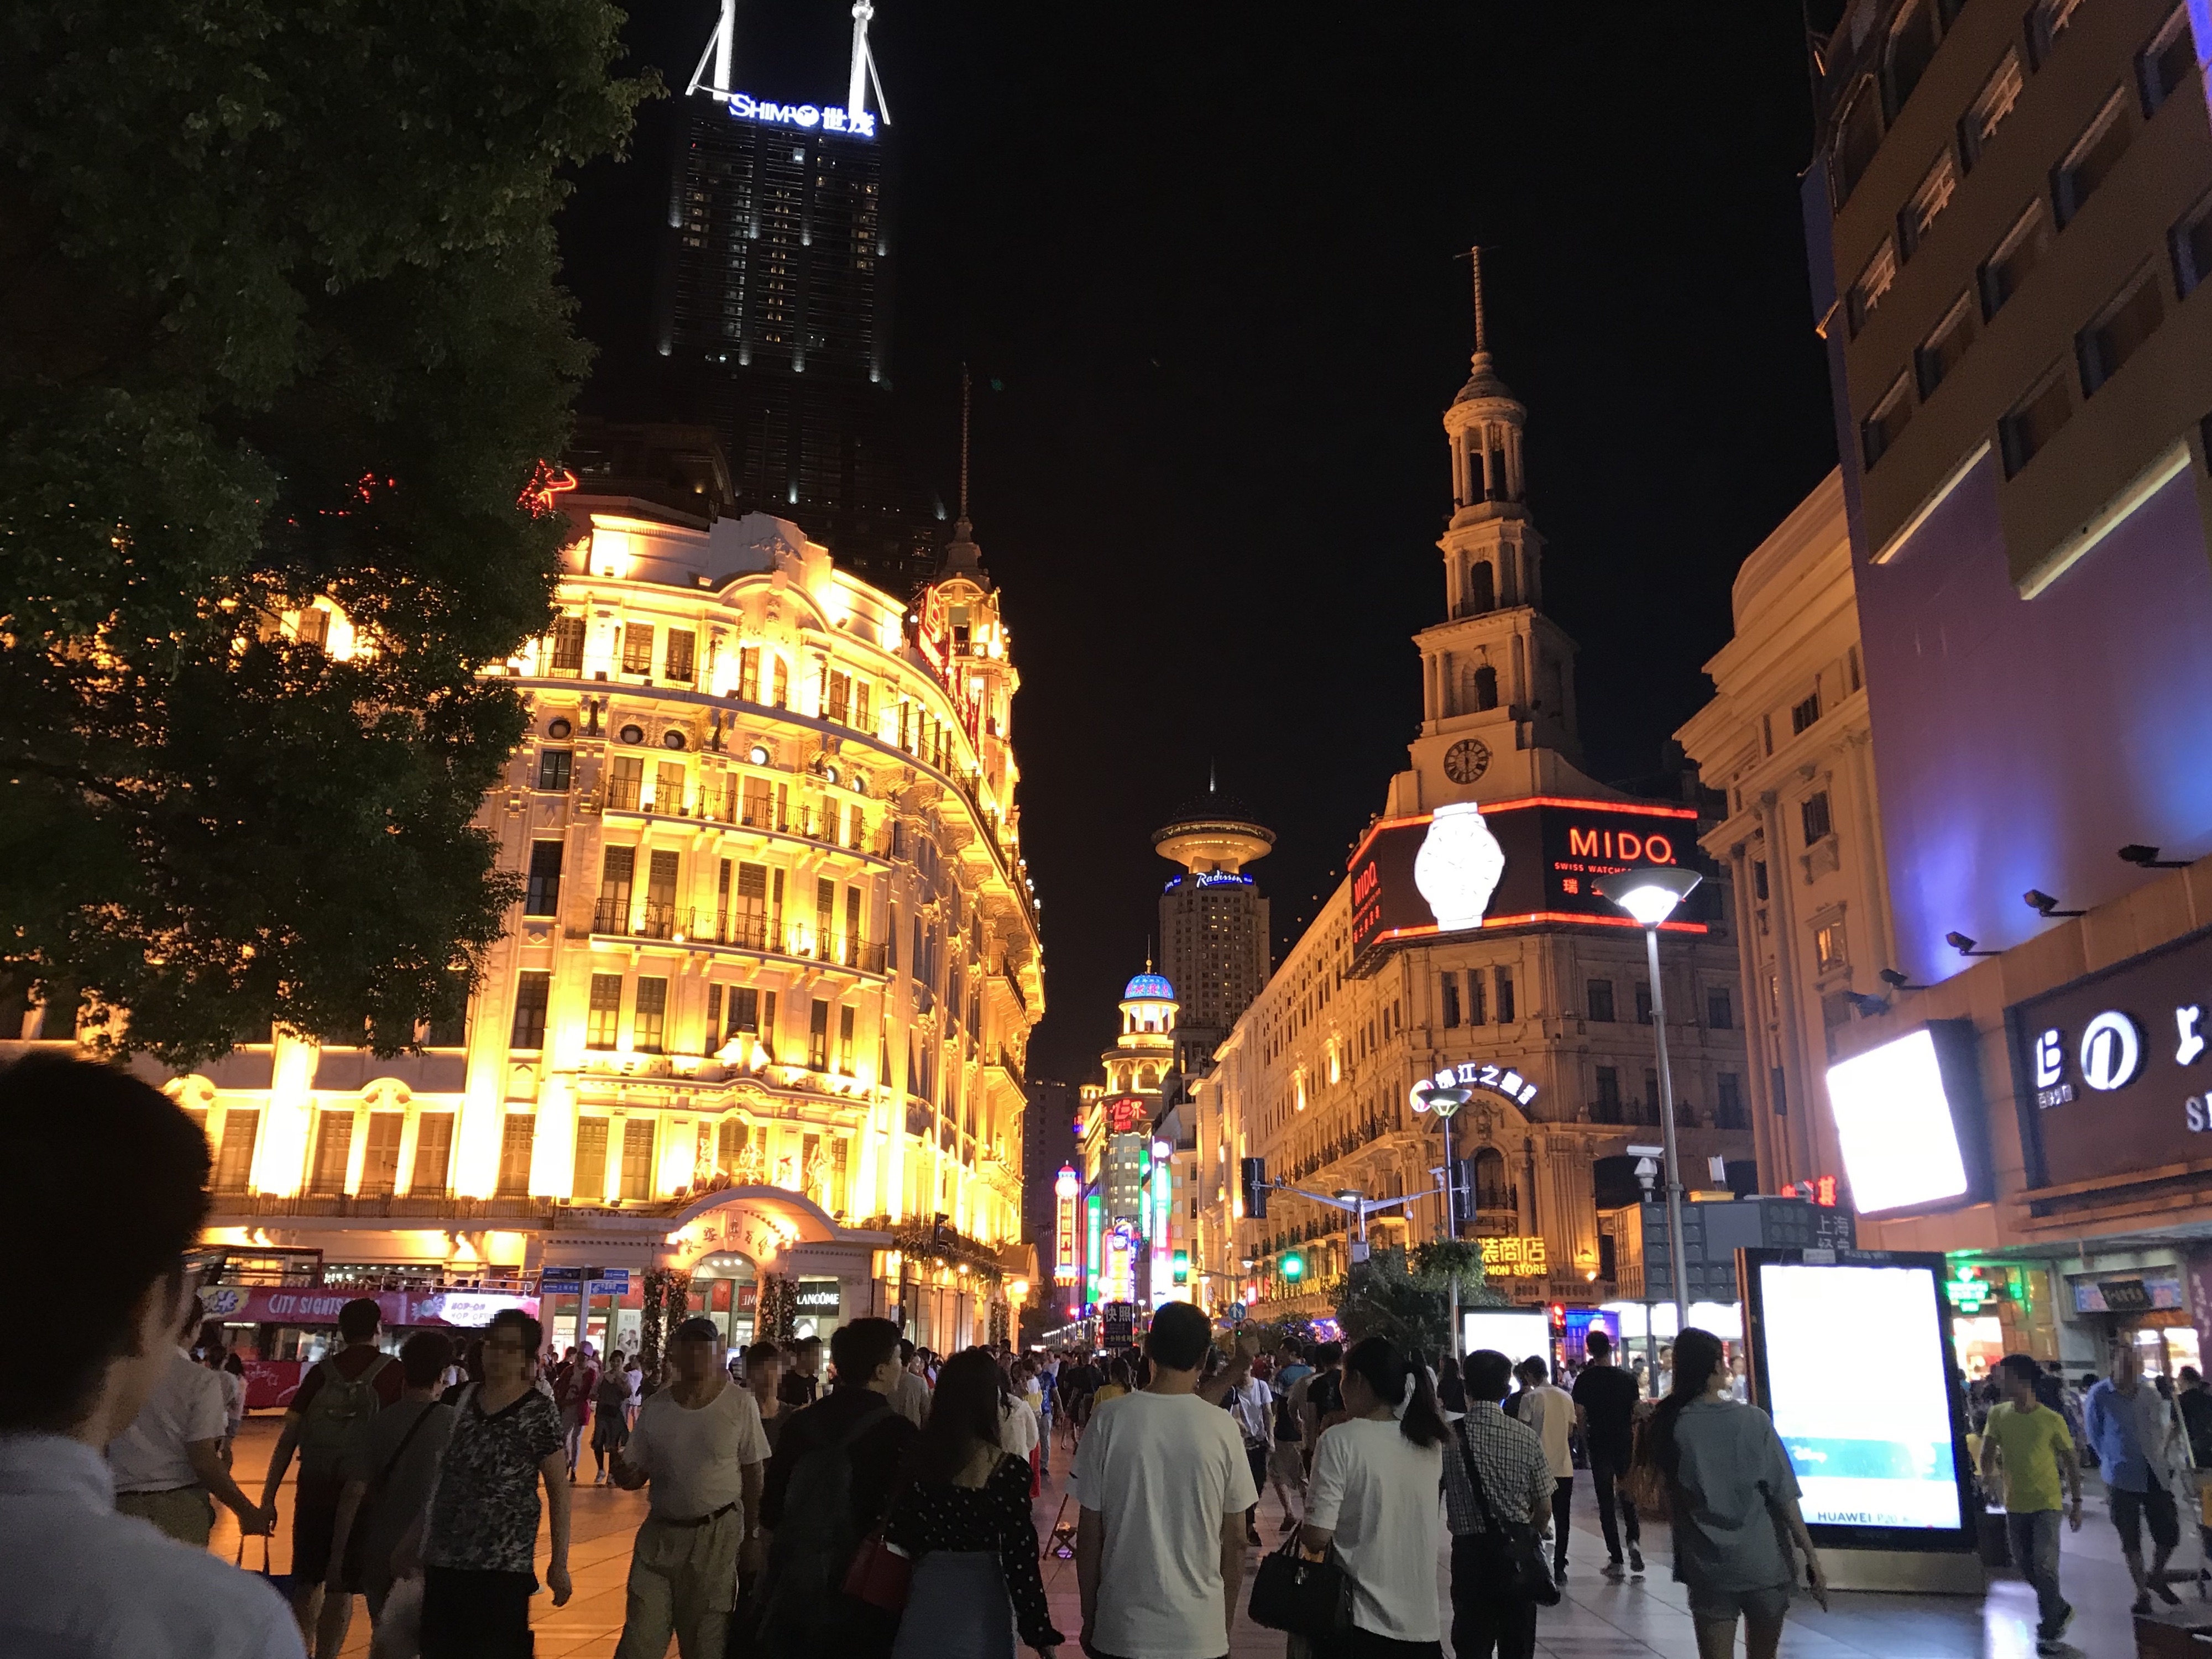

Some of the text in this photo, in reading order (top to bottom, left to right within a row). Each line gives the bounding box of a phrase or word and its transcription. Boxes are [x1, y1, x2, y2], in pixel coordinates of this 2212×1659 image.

[1570, 829, 1672, 863] MIDO
[1554, 862, 1632, 875] SWISS WATCH
[1196, 870, 1243, 888] Radisson
[1355, 861, 1376, 907] MIDO
[1817, 1214, 1849, 1237] 上海
[1480, 1237, 1546, 1263] 装商店
[1513, 1264, 1547, 1275] STORE
[268, 1294, 295, 1314] CITY
[797, 1292, 839, 1305] LANCÔME
[1105, 1305, 1131, 1322] 快照
[1817, 1511, 1872, 1524] HUAWEI
